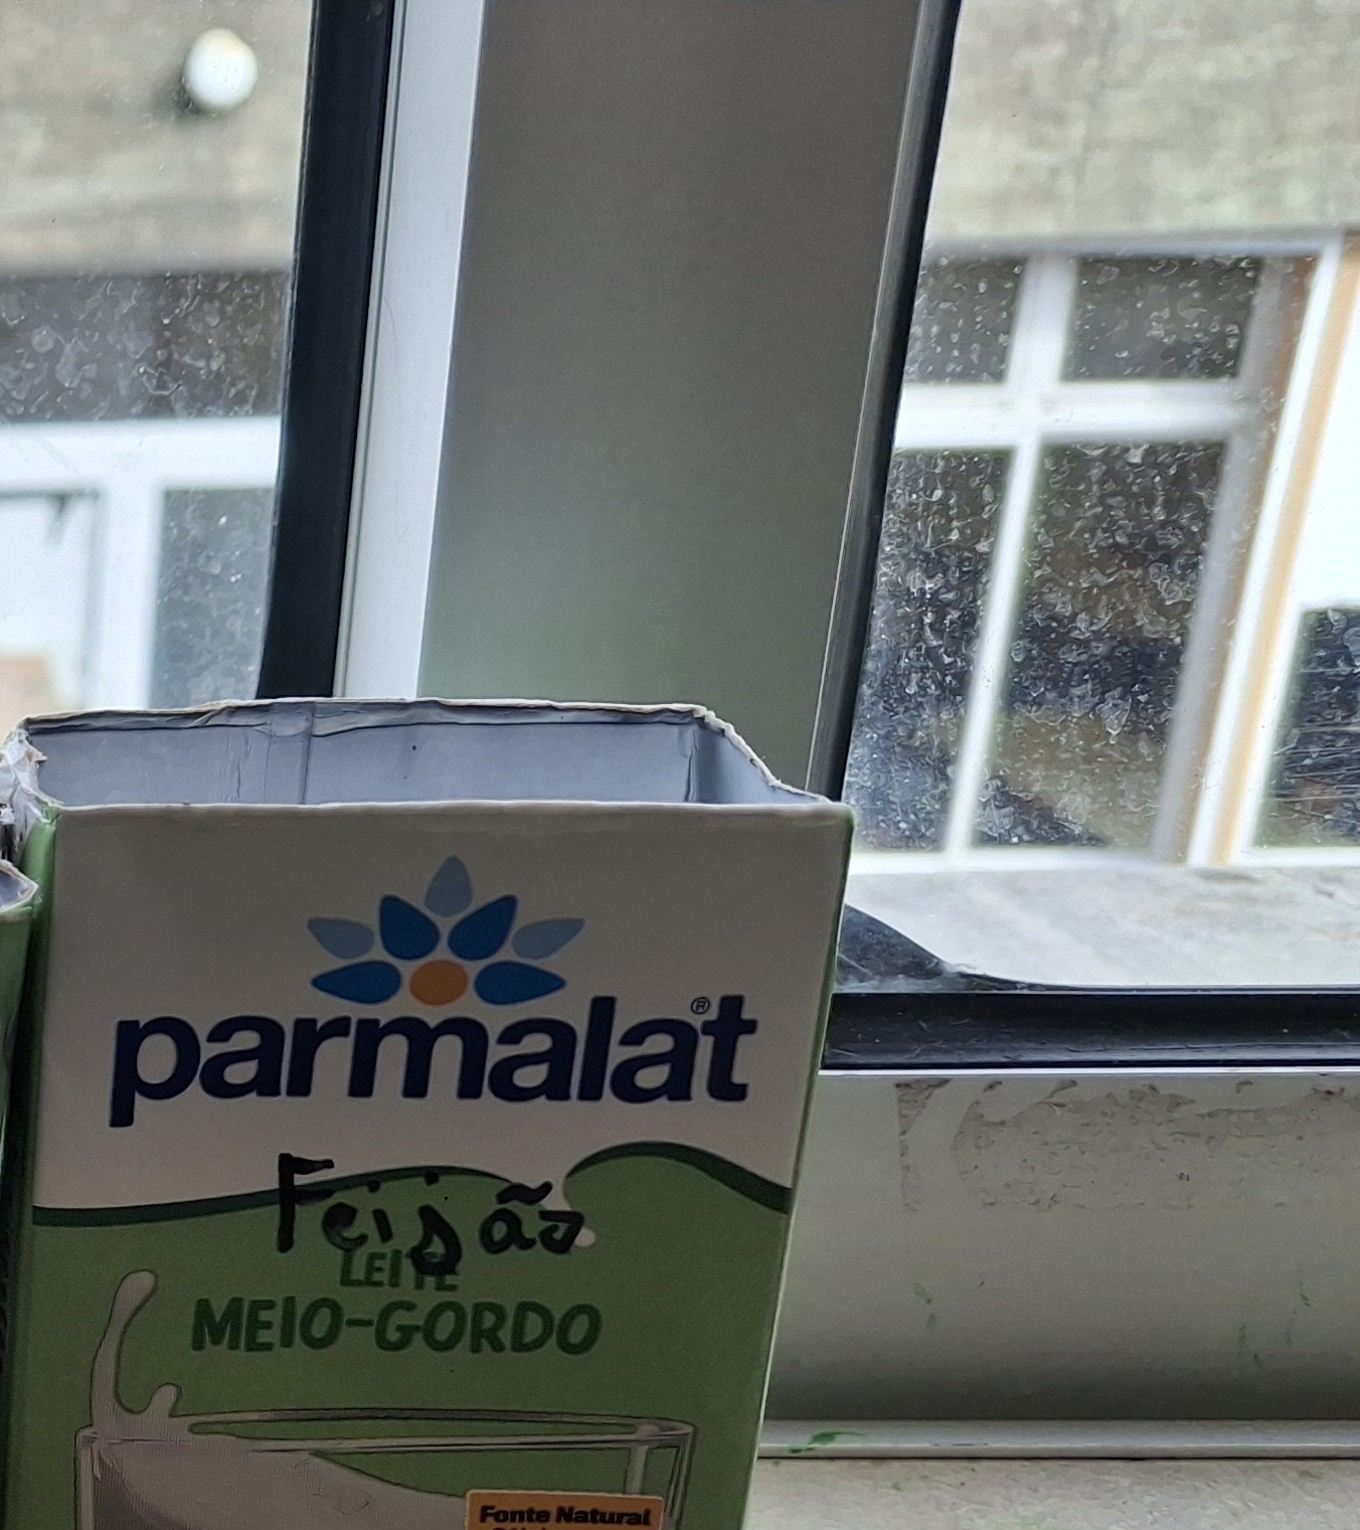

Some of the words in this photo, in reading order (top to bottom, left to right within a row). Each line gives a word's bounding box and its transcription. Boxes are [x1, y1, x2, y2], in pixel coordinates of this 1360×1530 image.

[109, 995, 758, 1127] parmalat
[191, 1297, 602, 1355] MEIO-GORDO
[480, 1505, 550, 1523] Fonte
[555, 1506, 651, 1525] Natural
